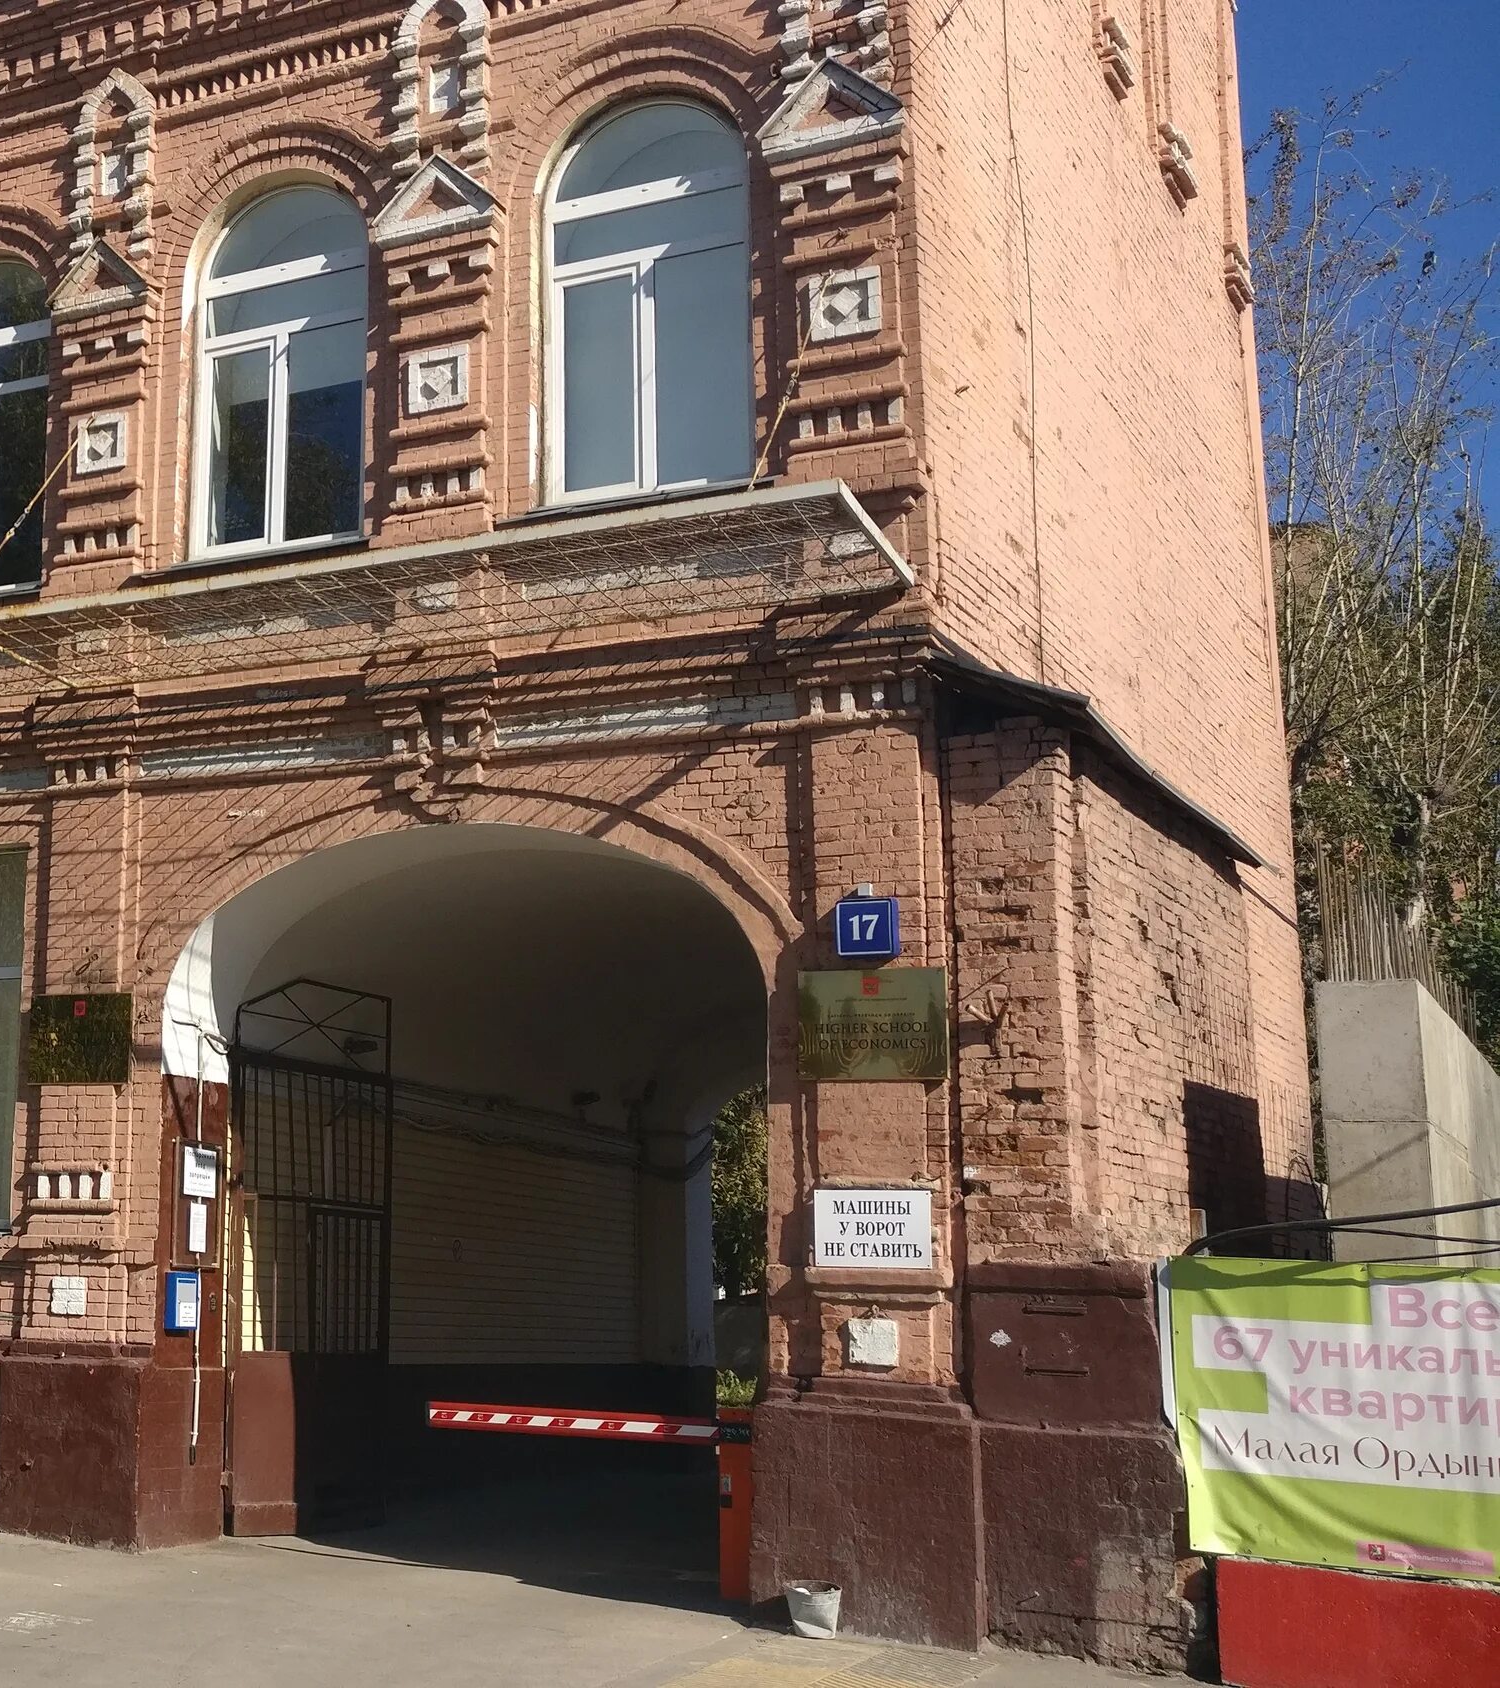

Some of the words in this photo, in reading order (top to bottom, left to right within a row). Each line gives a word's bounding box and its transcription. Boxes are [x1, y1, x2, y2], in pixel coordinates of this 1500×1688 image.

[848, 914, 879, 941] 17
[815, 1023, 869, 1034] HIGHER
[872, 1021, 930, 1033] SCHOOL
[819, 1039, 839, 1050] OF
[842, 1038, 926, 1050] ECONOMICS
[833, 1200, 911, 1215] МАШИНЫ
[839, 1222, 850, 1235] У
[855, 1222, 905, 1236] ВОРОТ
[824, 1243, 845, 1256] НЕ
[850, 1243, 922, 1258] СТАВИТЬ
[1388, 1286, 1500, 1332] Все
[1213, 1326, 1273, 1362] 67
[1213, 1424, 1339, 1466] Малая
[1353, 1436, 1500, 1481] Ордын
